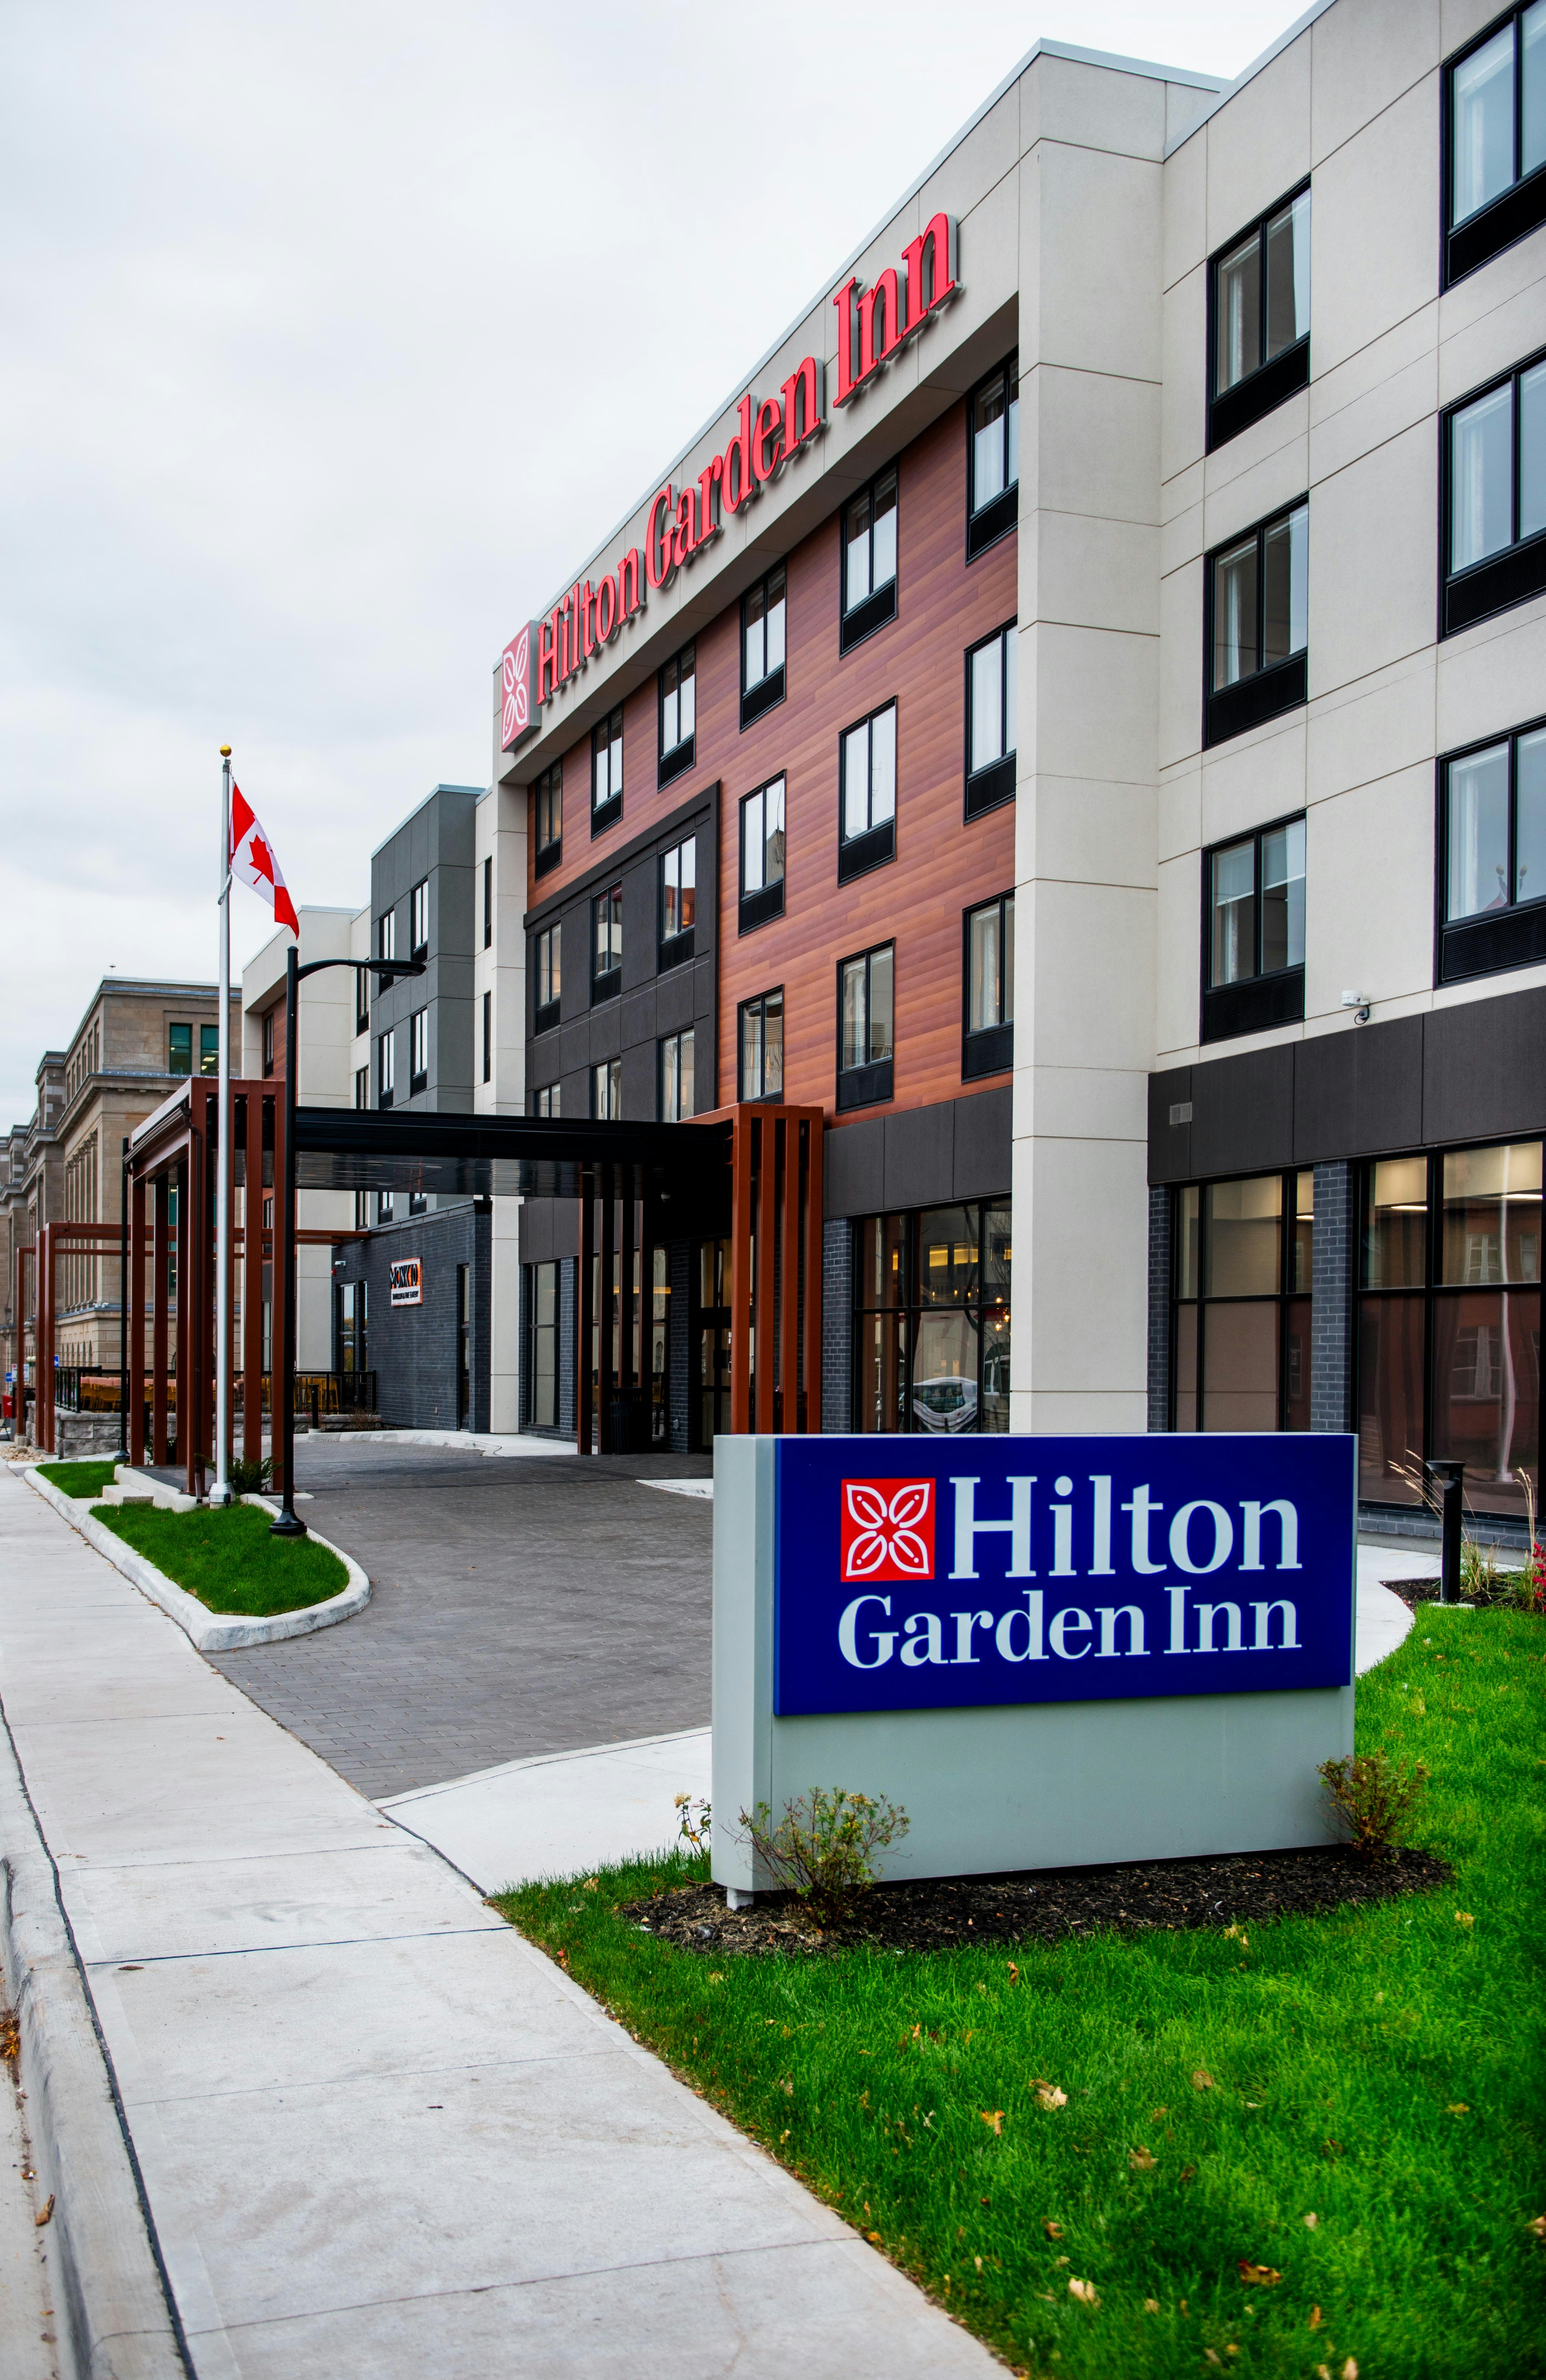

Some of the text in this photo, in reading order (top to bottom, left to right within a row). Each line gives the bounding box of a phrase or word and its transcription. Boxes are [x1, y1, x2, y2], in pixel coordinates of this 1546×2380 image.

[536, 213, 955, 705] Hilton Garden Inn
[390, 1264, 417, 1289] MONK 10
[948, 1475, 1302, 1579] Hilton
[838, 1587, 1302, 1668] Garden Inn
